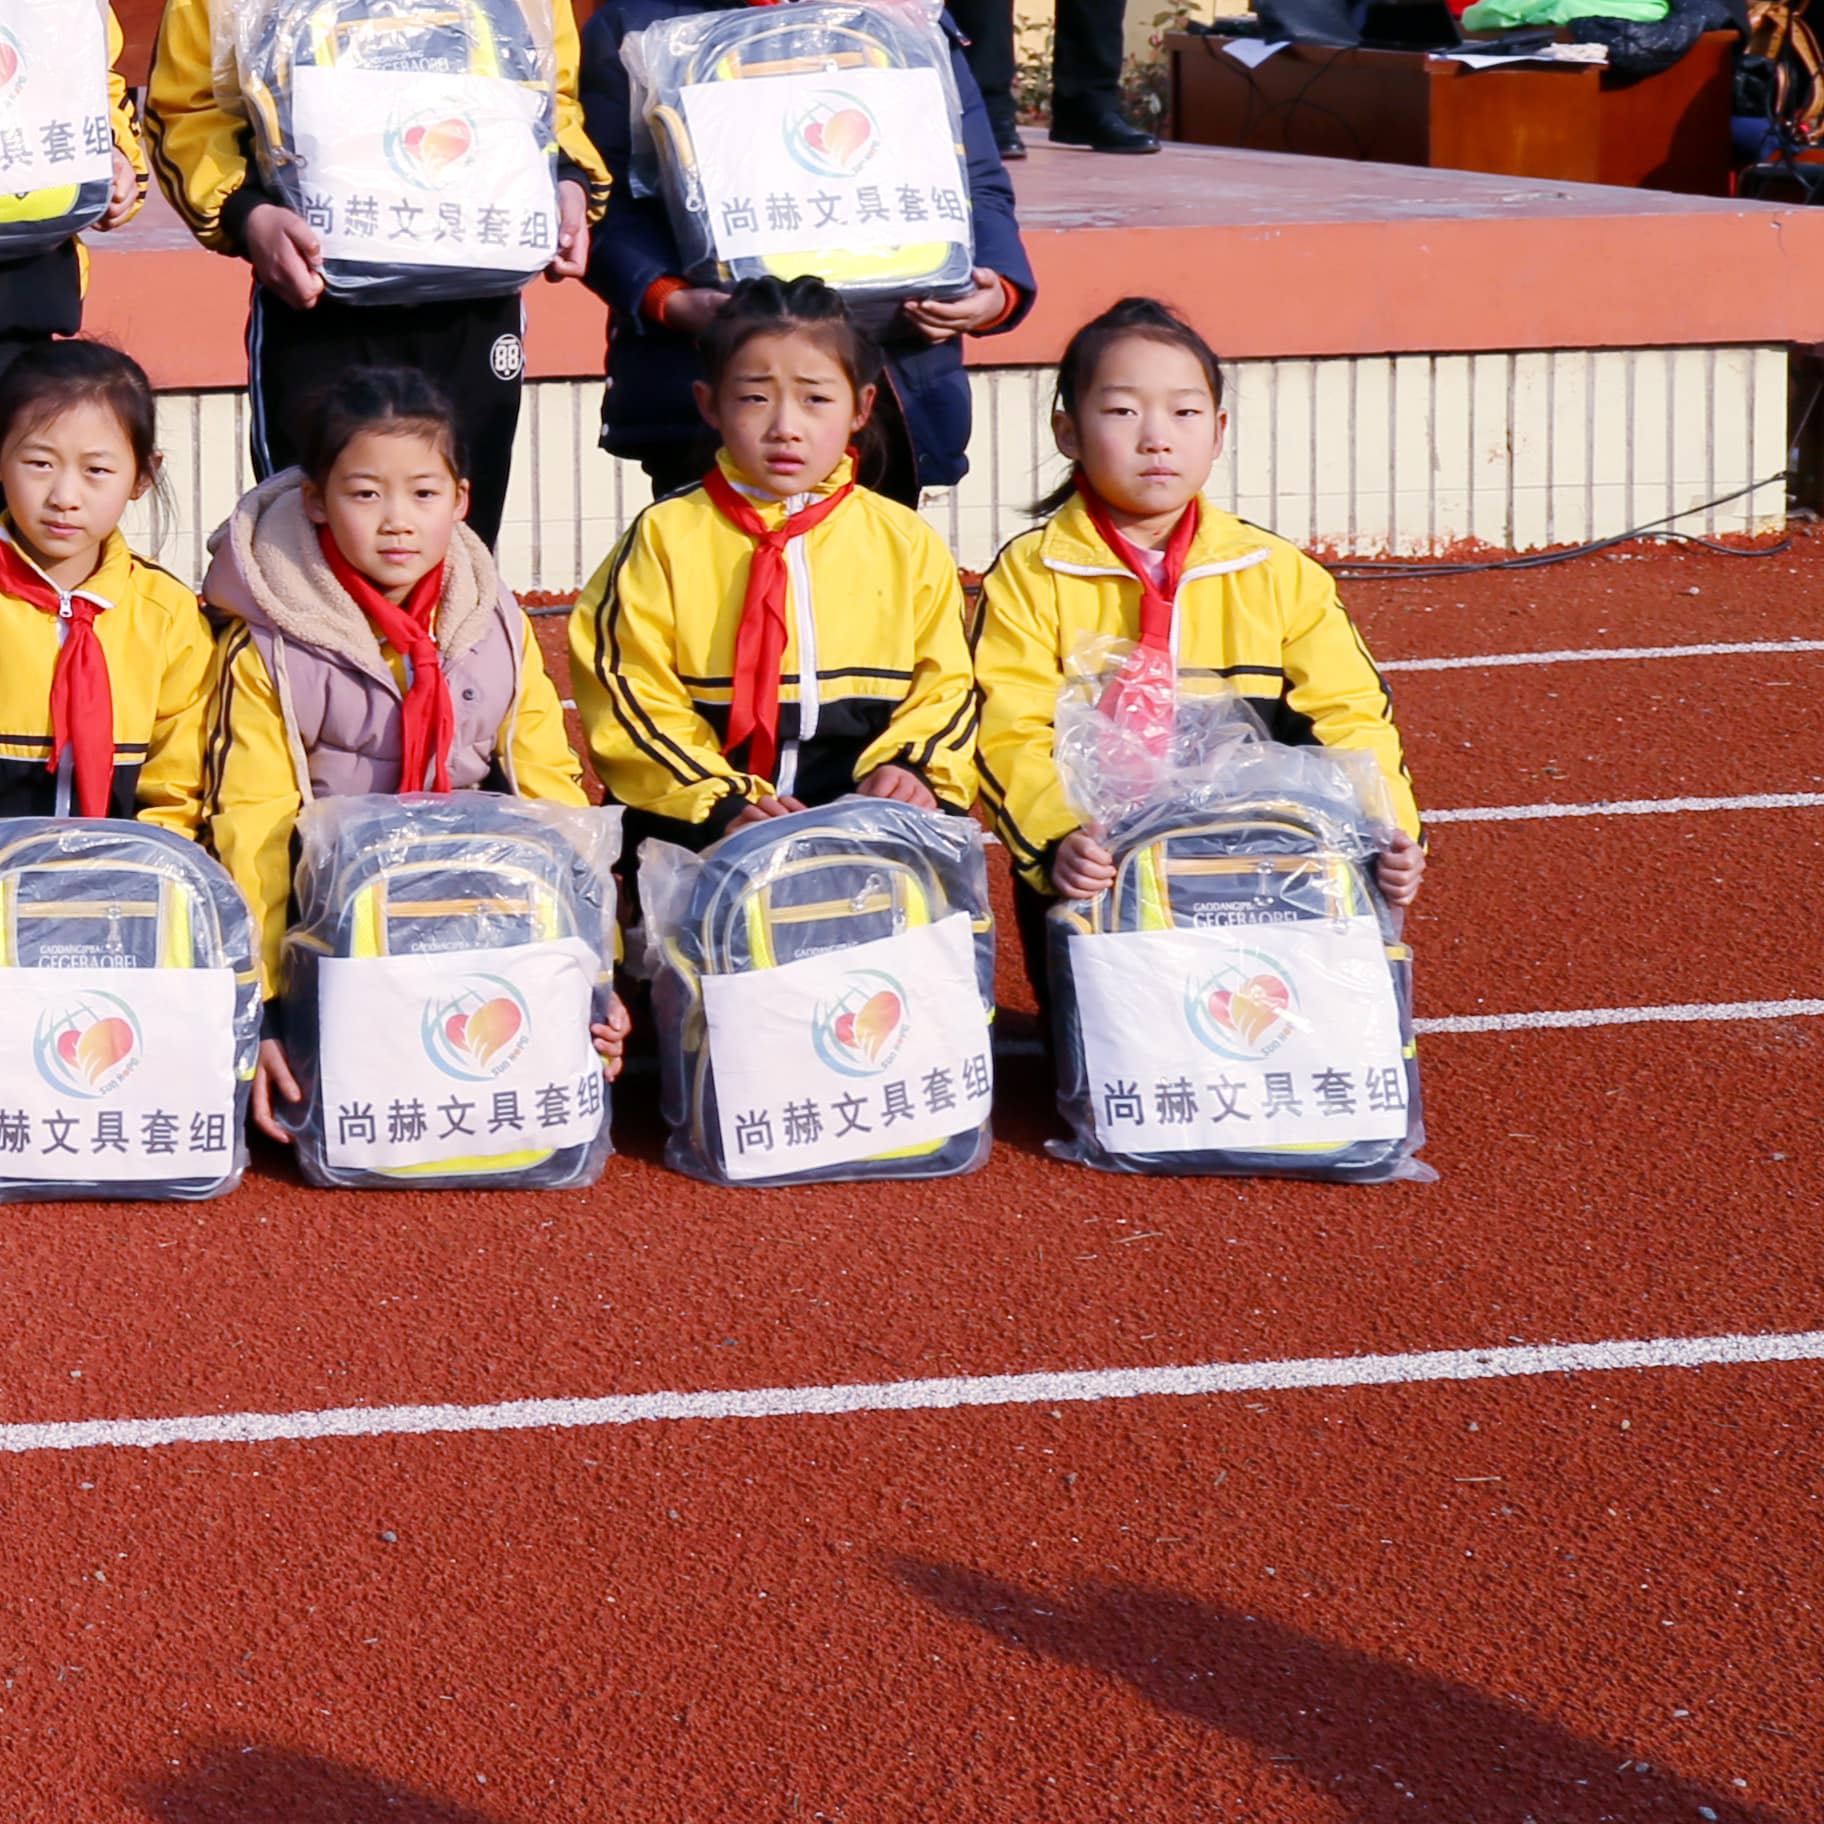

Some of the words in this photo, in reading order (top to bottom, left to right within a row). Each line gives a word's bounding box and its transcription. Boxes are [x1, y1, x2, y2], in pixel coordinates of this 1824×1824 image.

[302, 195, 551, 250] 尚赫文具套组
[722, 185, 967, 236] 尚赫文具套组
[495, 345, 519, 371] 88
[338, 1073, 602, 1146] 尚赫文具套组
[735, 1058, 992, 1153] 尚赫文具套组
[1104, 1065, 1406, 1129] 尚赫文具套组
